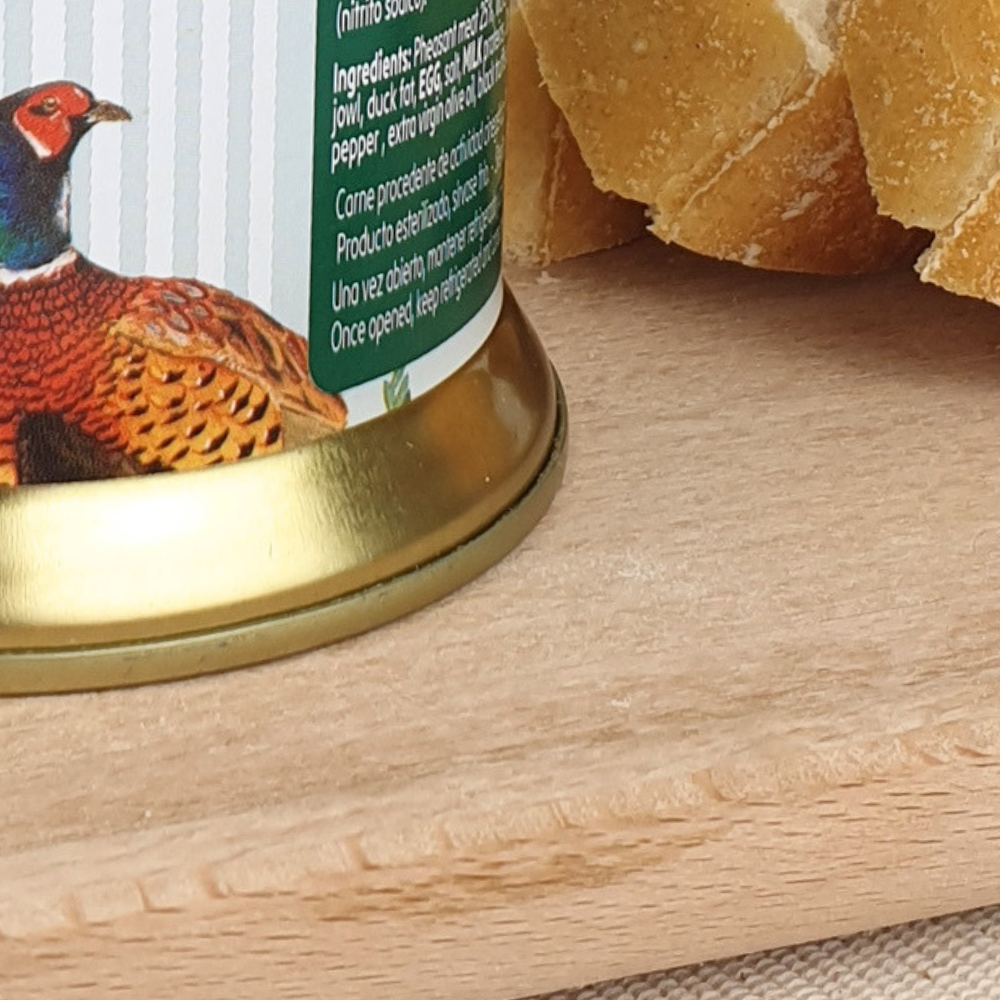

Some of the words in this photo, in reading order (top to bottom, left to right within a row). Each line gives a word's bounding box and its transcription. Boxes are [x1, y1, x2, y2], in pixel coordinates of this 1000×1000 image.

[330, 92, 364, 139] jowl,
[366, 82, 397, 119] duck
[399, 76, 416, 108] fat,
[418, 60, 443, 100] EGG,
[462, 35, 483, 73] MILK
[333, 45, 412, 99] Ingredients:
[413, 20, 457, 67] Pheasant
[458, 10, 479, 41] meat
[387, 114, 416, 148] extra
[418, 98, 444, 138] virgin
[445, 87, 464, 120] olive
[336, 187, 375, 220] Carne
[377, 157, 437, 215] procedente
[437, 147, 449, 178] de
[332, 279, 359, 312] Una
[362, 271, 384, 300] vez
[385, 253, 425, 292] abierto,
[427, 226, 466, 271] mantener
[336, 224, 394, 264] Producto
[330, 320, 366, 353] Once
[368, 293, 414, 346] opened,
[415, 284, 439, 318] keep
